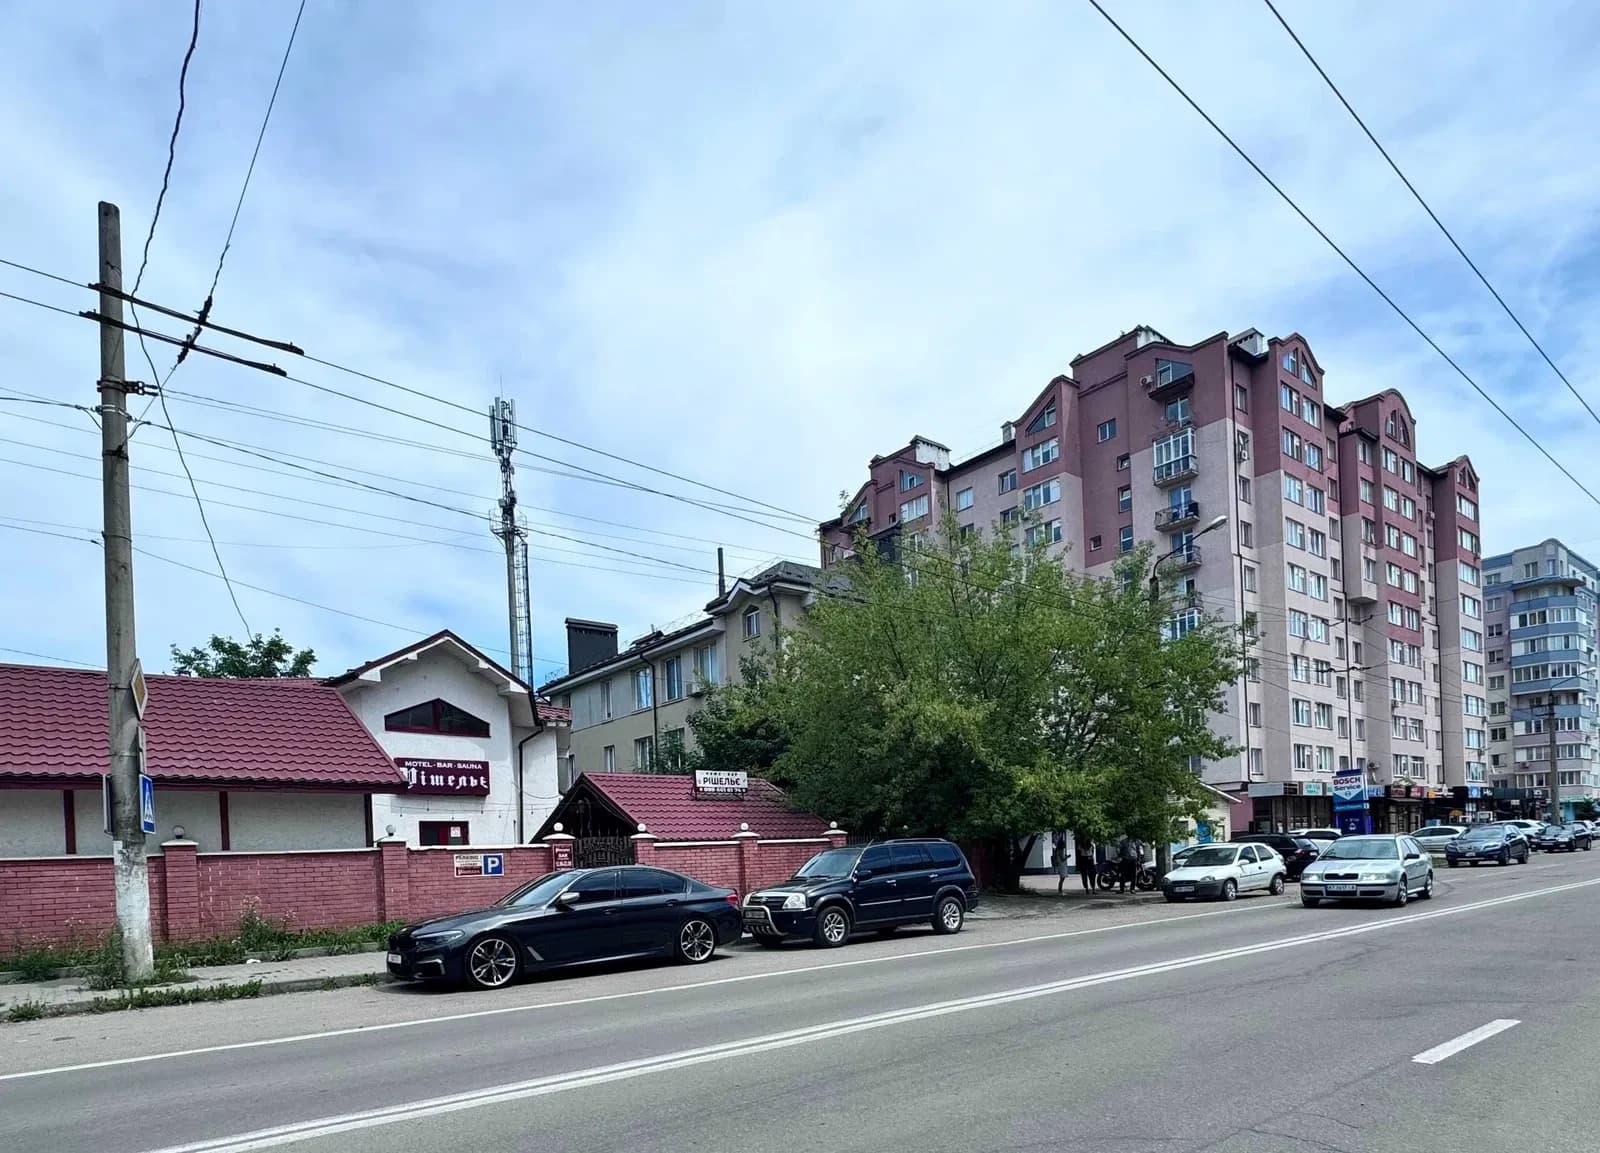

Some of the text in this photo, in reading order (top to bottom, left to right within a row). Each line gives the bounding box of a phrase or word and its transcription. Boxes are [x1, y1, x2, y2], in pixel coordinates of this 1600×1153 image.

[703, 776, 741, 786] РІШЕЛЬЄ
[1333, 776, 1361, 786] BOSCH
[487, 857, 500, 873] P
